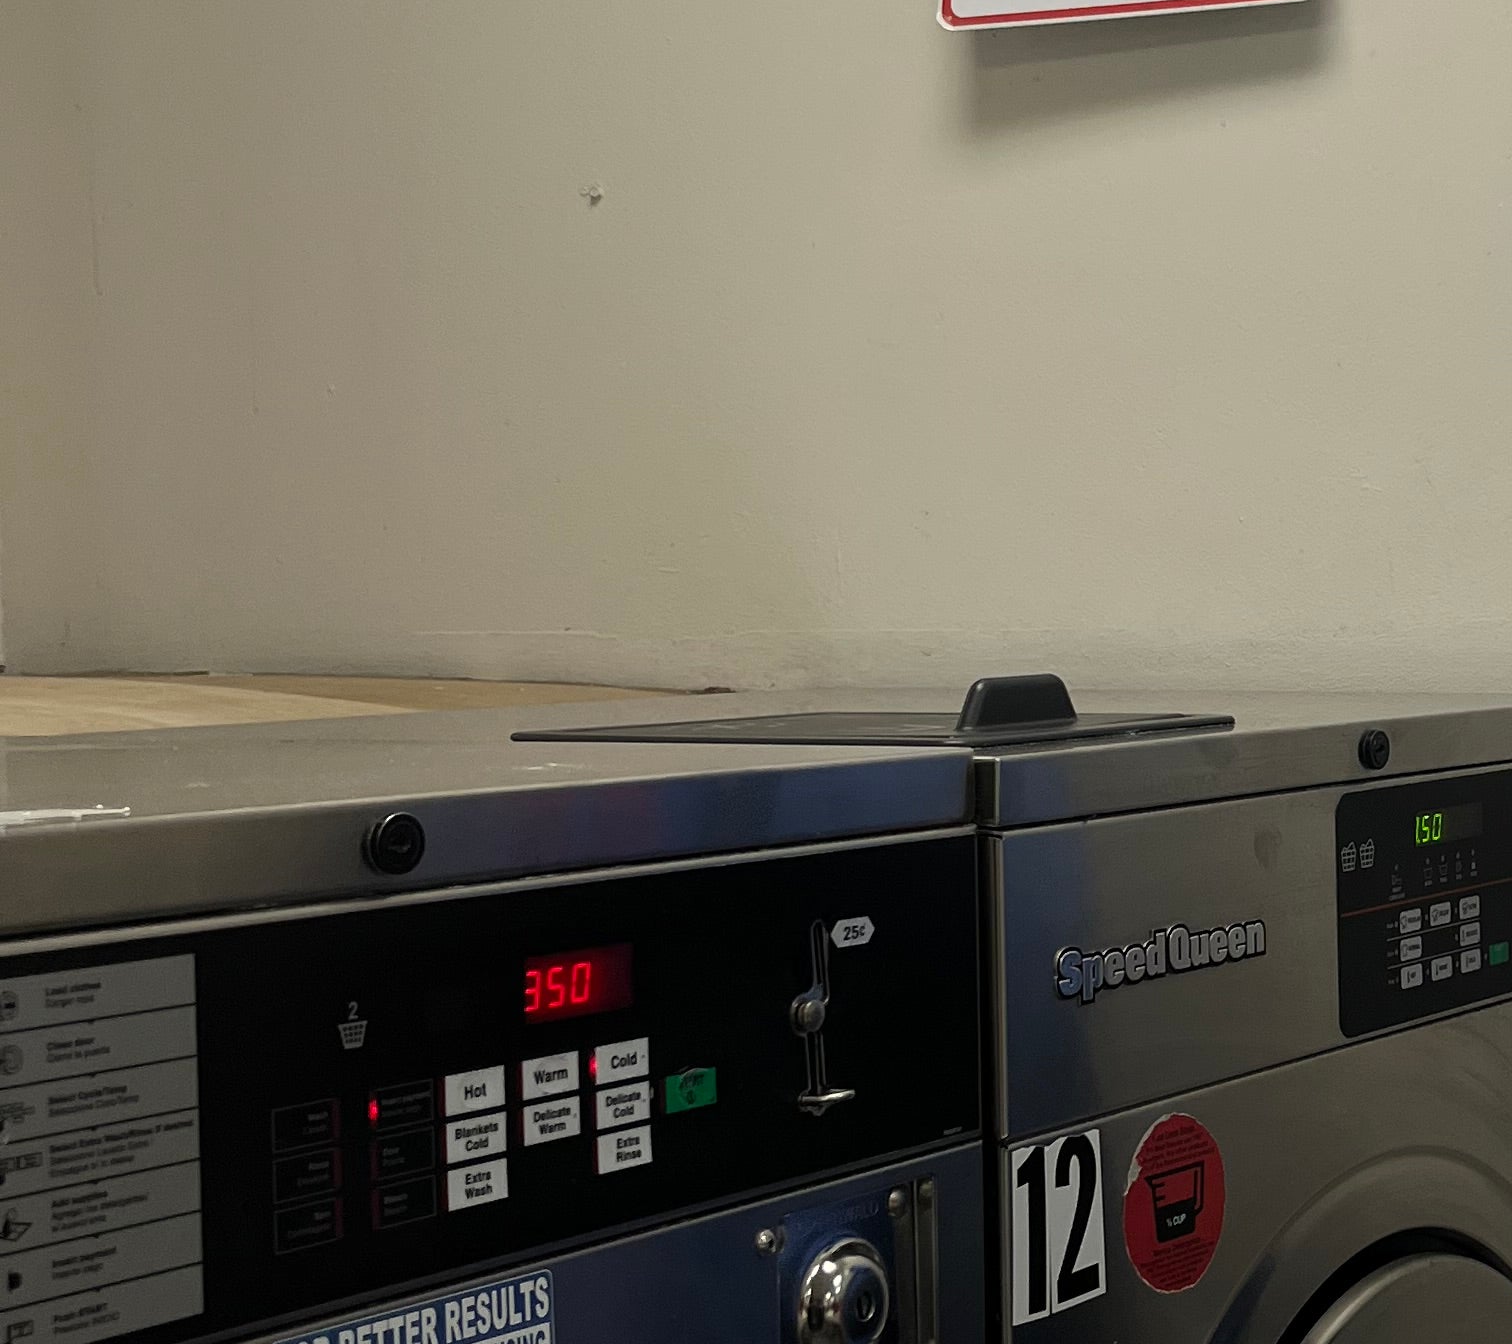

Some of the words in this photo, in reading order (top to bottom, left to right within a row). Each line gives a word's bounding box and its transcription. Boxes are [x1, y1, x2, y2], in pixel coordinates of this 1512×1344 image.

[348, 1000, 359, 1021] 2
[610, 1051, 638, 1070] Cold
[533, 1068, 568, 1085] Warm
[464, 1083, 487, 1101] Hot
[605, 1090, 641, 1107] Delicate
[533, 1106, 571, 1123] Delicate
[613, 1104, 635, 1119] Cold
[455, 1122, 498, 1141] Blankets
[538, 1121, 567, 1135] Warm
[465, 1137, 489, 1152] Cold
[616, 1136, 640, 1150] Extra
[616, 1148, 642, 1162] Rinse
[465, 1170, 492, 1186] Extra
[464, 1183, 493, 1200] Wash
[1017, 1135, 1100, 1315] 12
[445, 1276, 551, 1344] RESULTS
